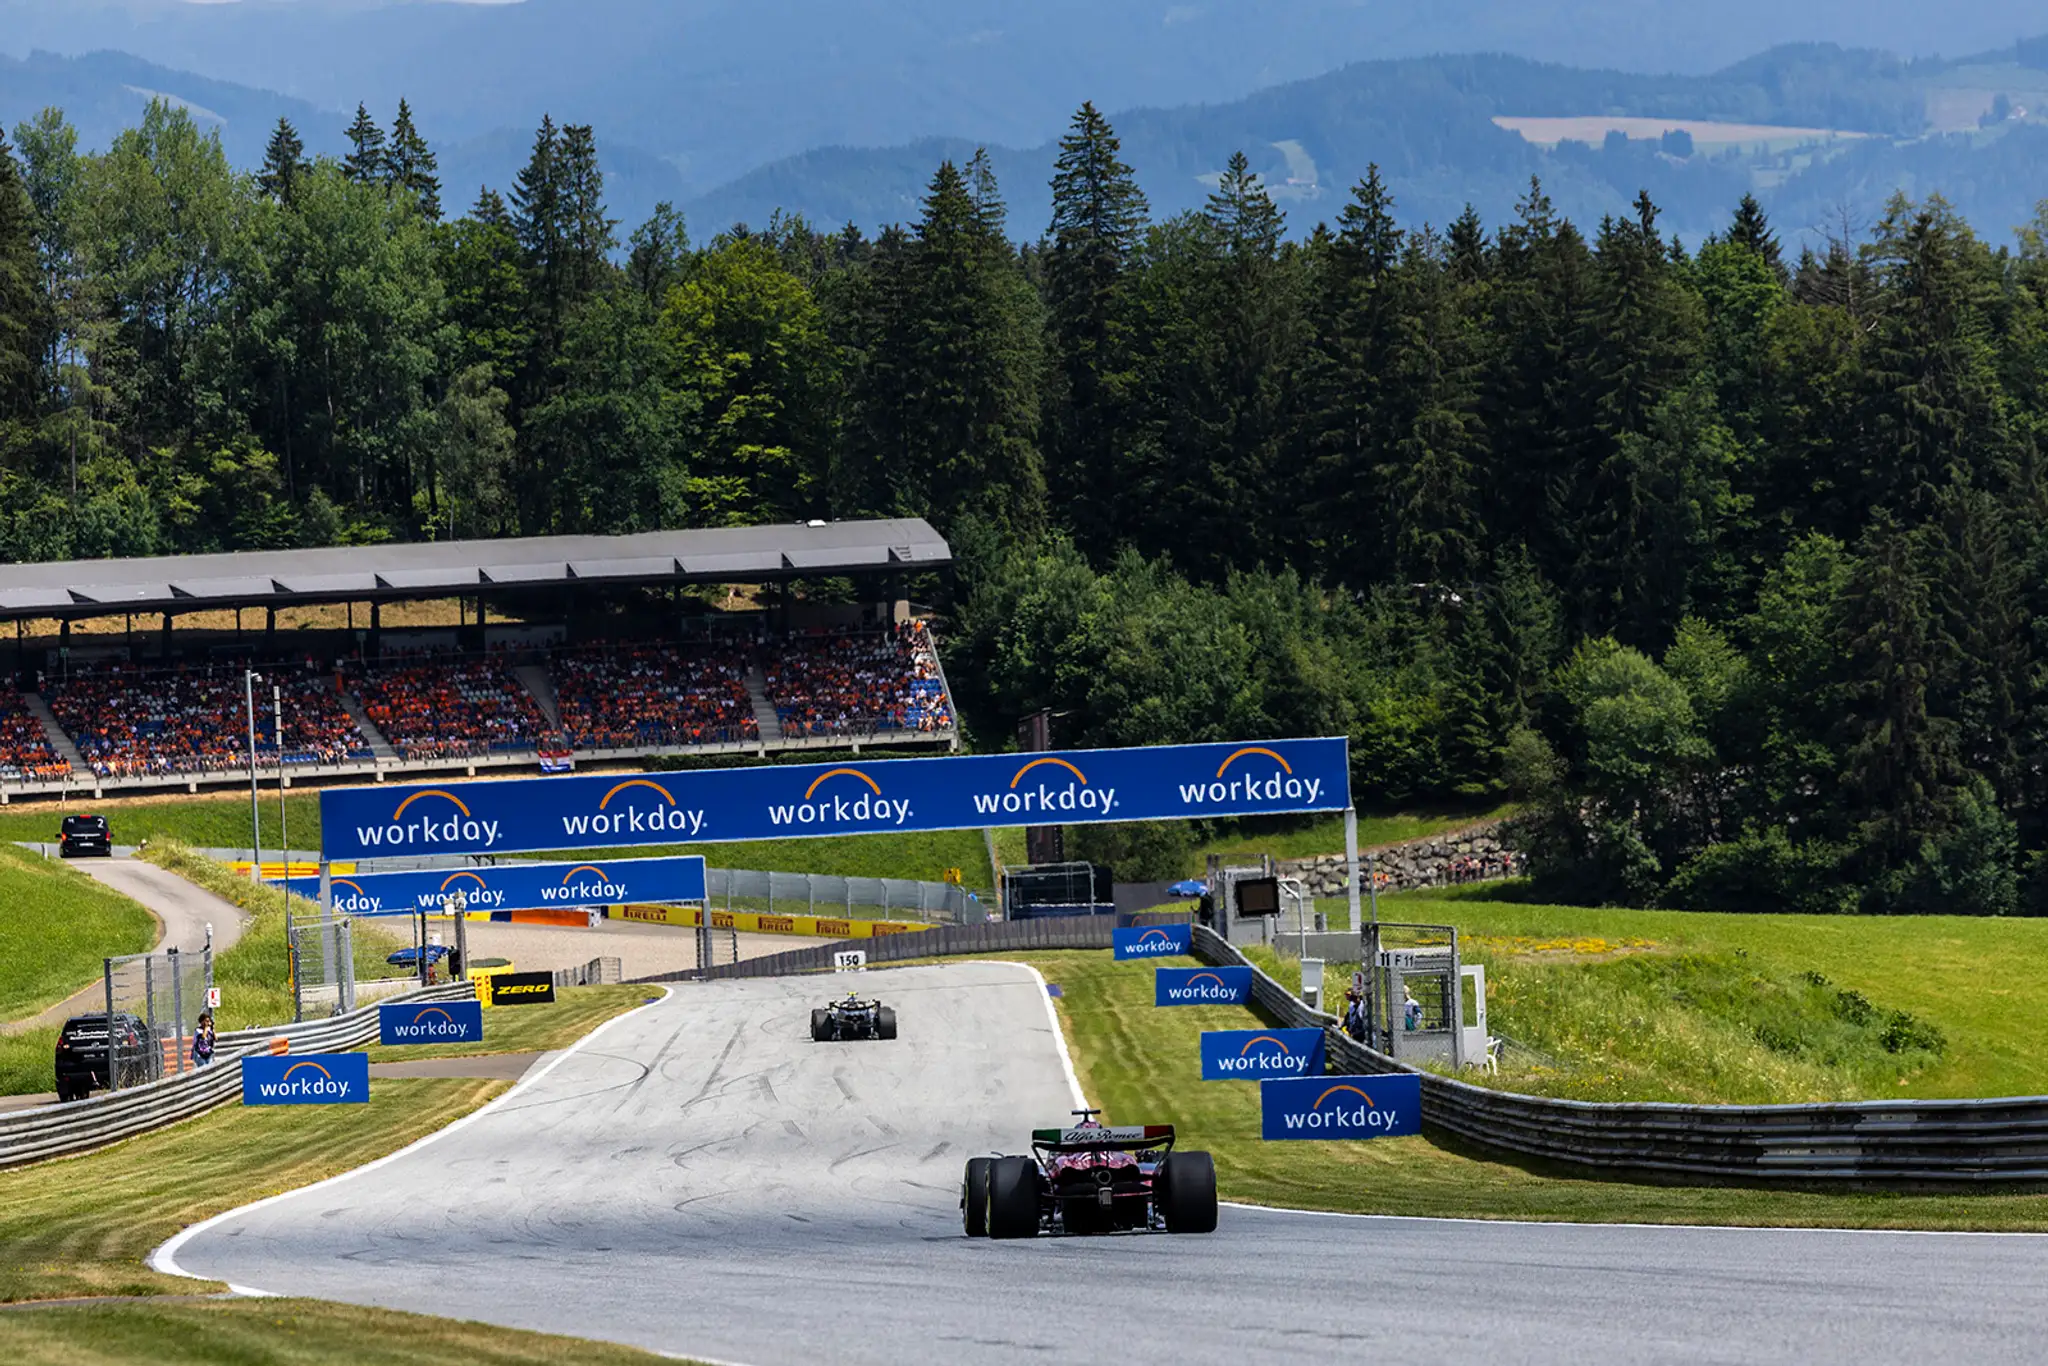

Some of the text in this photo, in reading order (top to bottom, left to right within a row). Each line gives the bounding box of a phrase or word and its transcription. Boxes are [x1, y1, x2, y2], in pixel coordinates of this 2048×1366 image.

[97, 818, 104, 829] 2
[839, 954, 859, 966] 150
[497, 984, 550, 995] ZERO
[1096, 1129, 1142, 1140] Romeo
